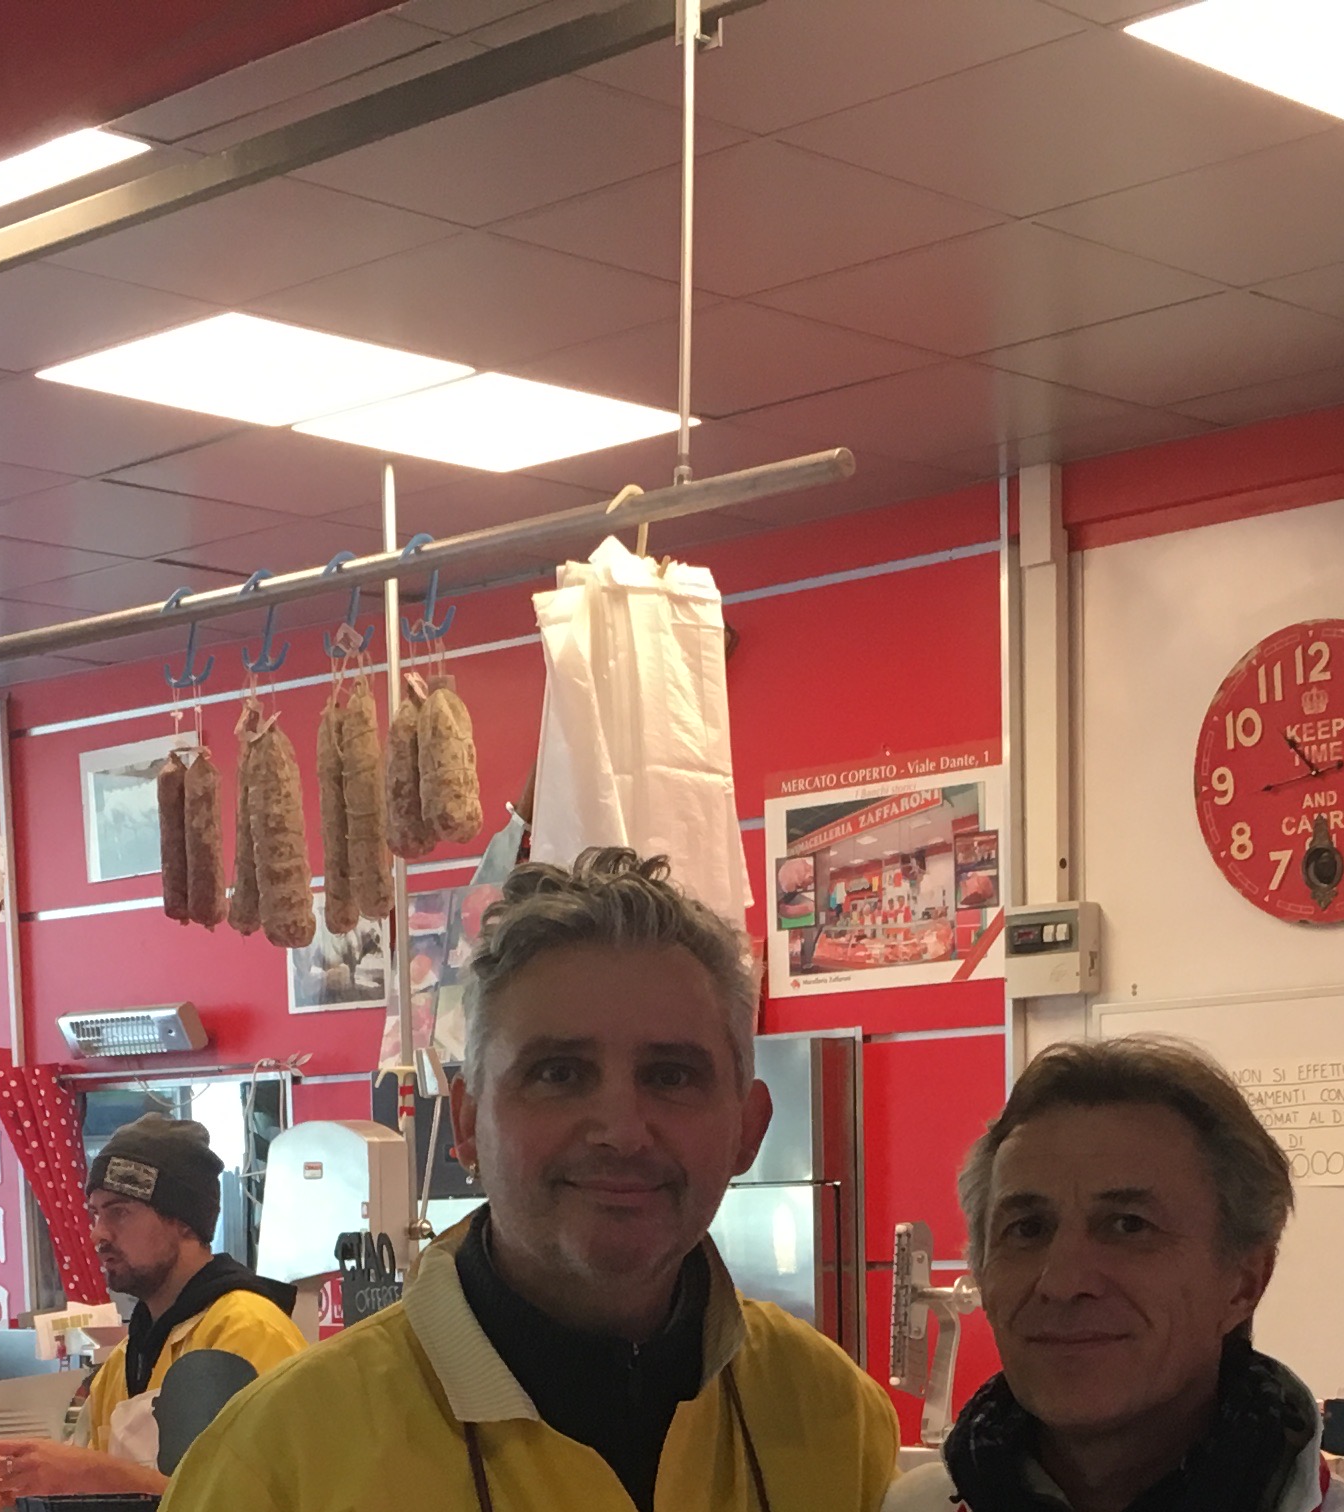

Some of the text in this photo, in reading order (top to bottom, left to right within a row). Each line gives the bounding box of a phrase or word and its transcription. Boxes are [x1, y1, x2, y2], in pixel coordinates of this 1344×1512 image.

[1258, 660, 1284, 704] 11
[1295, 641, 1332, 685] 12
[1225, 707, 1263, 750] 10
[781, 773, 837, 794] MERCATO
[840, 764, 897, 786] COPERTO
[908, 759, 936, 774] Viale
[940, 753, 979, 770] Dante,
[983, 750, 990, 763] 1
[1211, 766, 1234, 805] 9
[858, 788, 940, 828] ZAFFARONI
[1302, 790, 1338, 809] AND
[1230, 822, 1254, 861] 8
[1268, 849, 1293, 891] 7
[1232, 1068, 1262, 1084] NON
[1272, 1067, 1286, 1083] SI
[1245, 1088, 1306, 1107] GAMENTI
[1309, 1111, 1325, 1124] AL
[1288, 1134, 1303, 1148] DI
